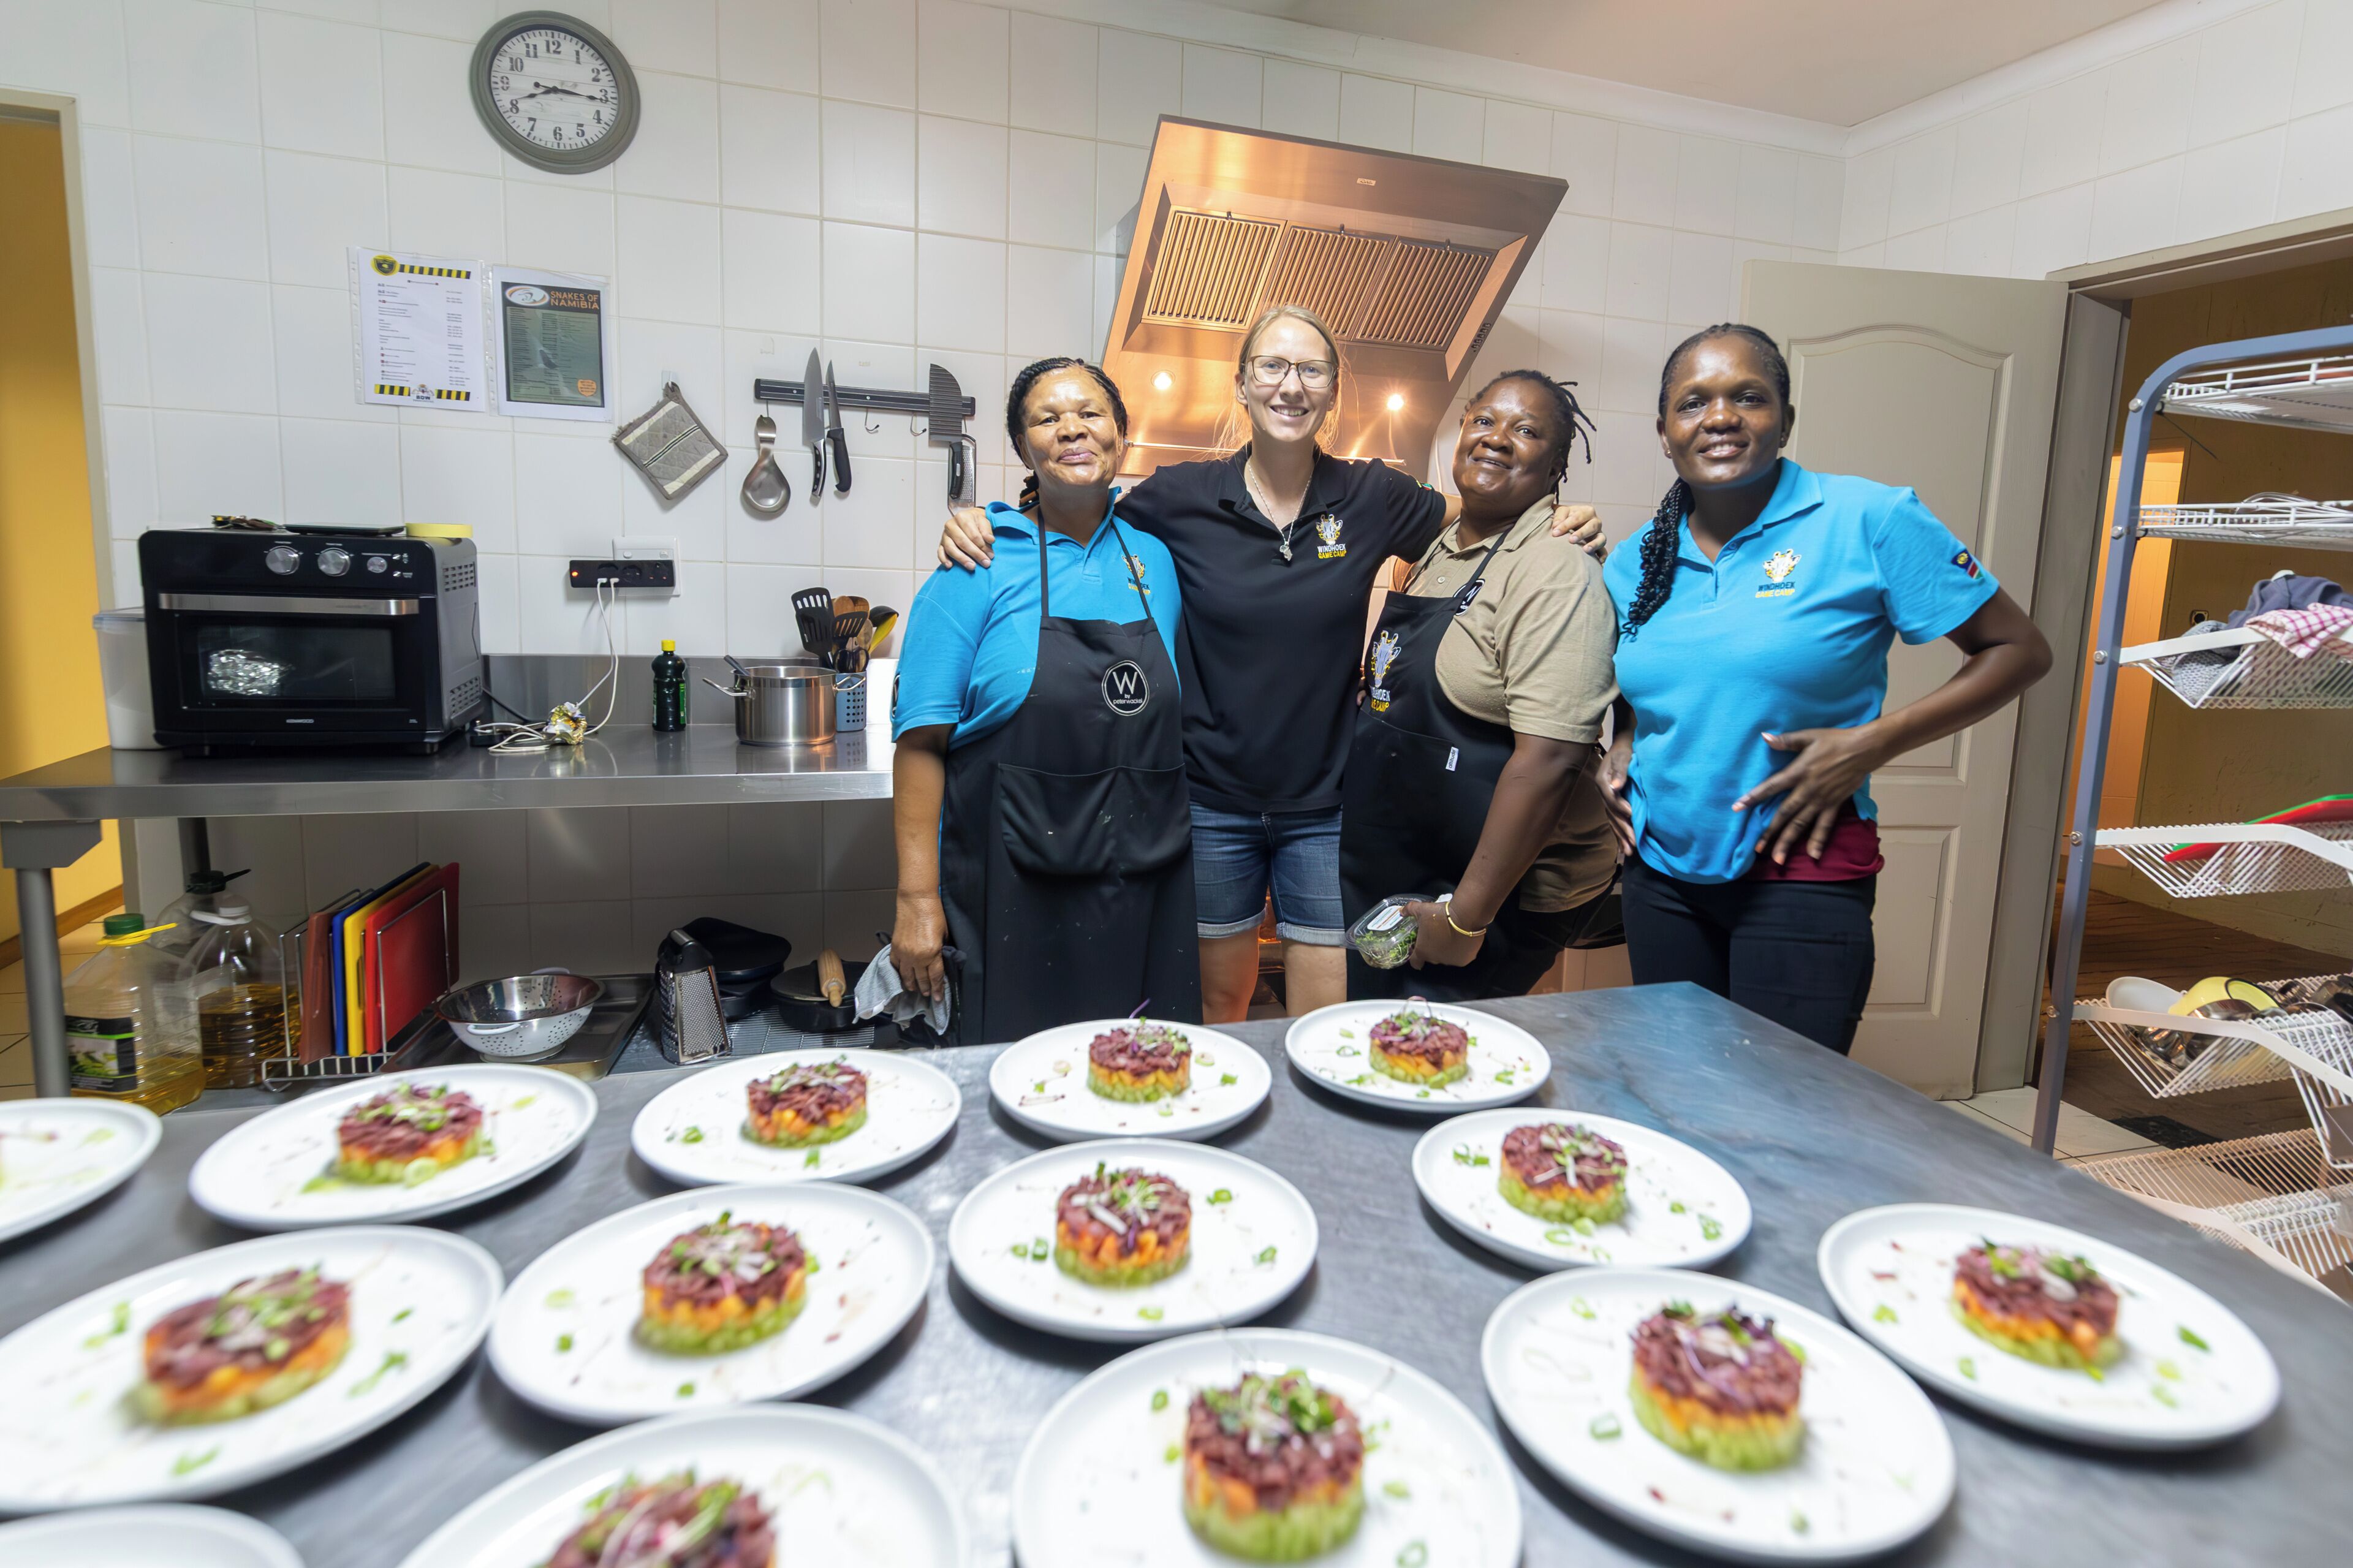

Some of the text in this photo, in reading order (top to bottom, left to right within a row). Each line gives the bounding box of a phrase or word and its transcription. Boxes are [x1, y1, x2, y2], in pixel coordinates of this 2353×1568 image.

[525, 43, 539, 59] 11
[545, 40, 561, 55] 12
[575, 50, 581, 64] 1
[509, 57, 524, 72] 10
[591, 68, 602, 82] 2
[500, 76, 510, 91] 9
[599, 89, 608, 104] 3
[510, 99, 519, 114] 8
[593, 110, 602, 124] 4
[528, 118, 537, 132] 7
[576, 123, 585, 137] 5
[553, 127, 563, 140] 6
[550, 291, 585, 300] SNAKES
[551, 298, 599, 309] NAMIBIA
[1317, 543, 1346, 553] WINDHOEK
[1758, 581, 1795, 591] WINDHOEK
[1113, 672, 1138, 694] W
